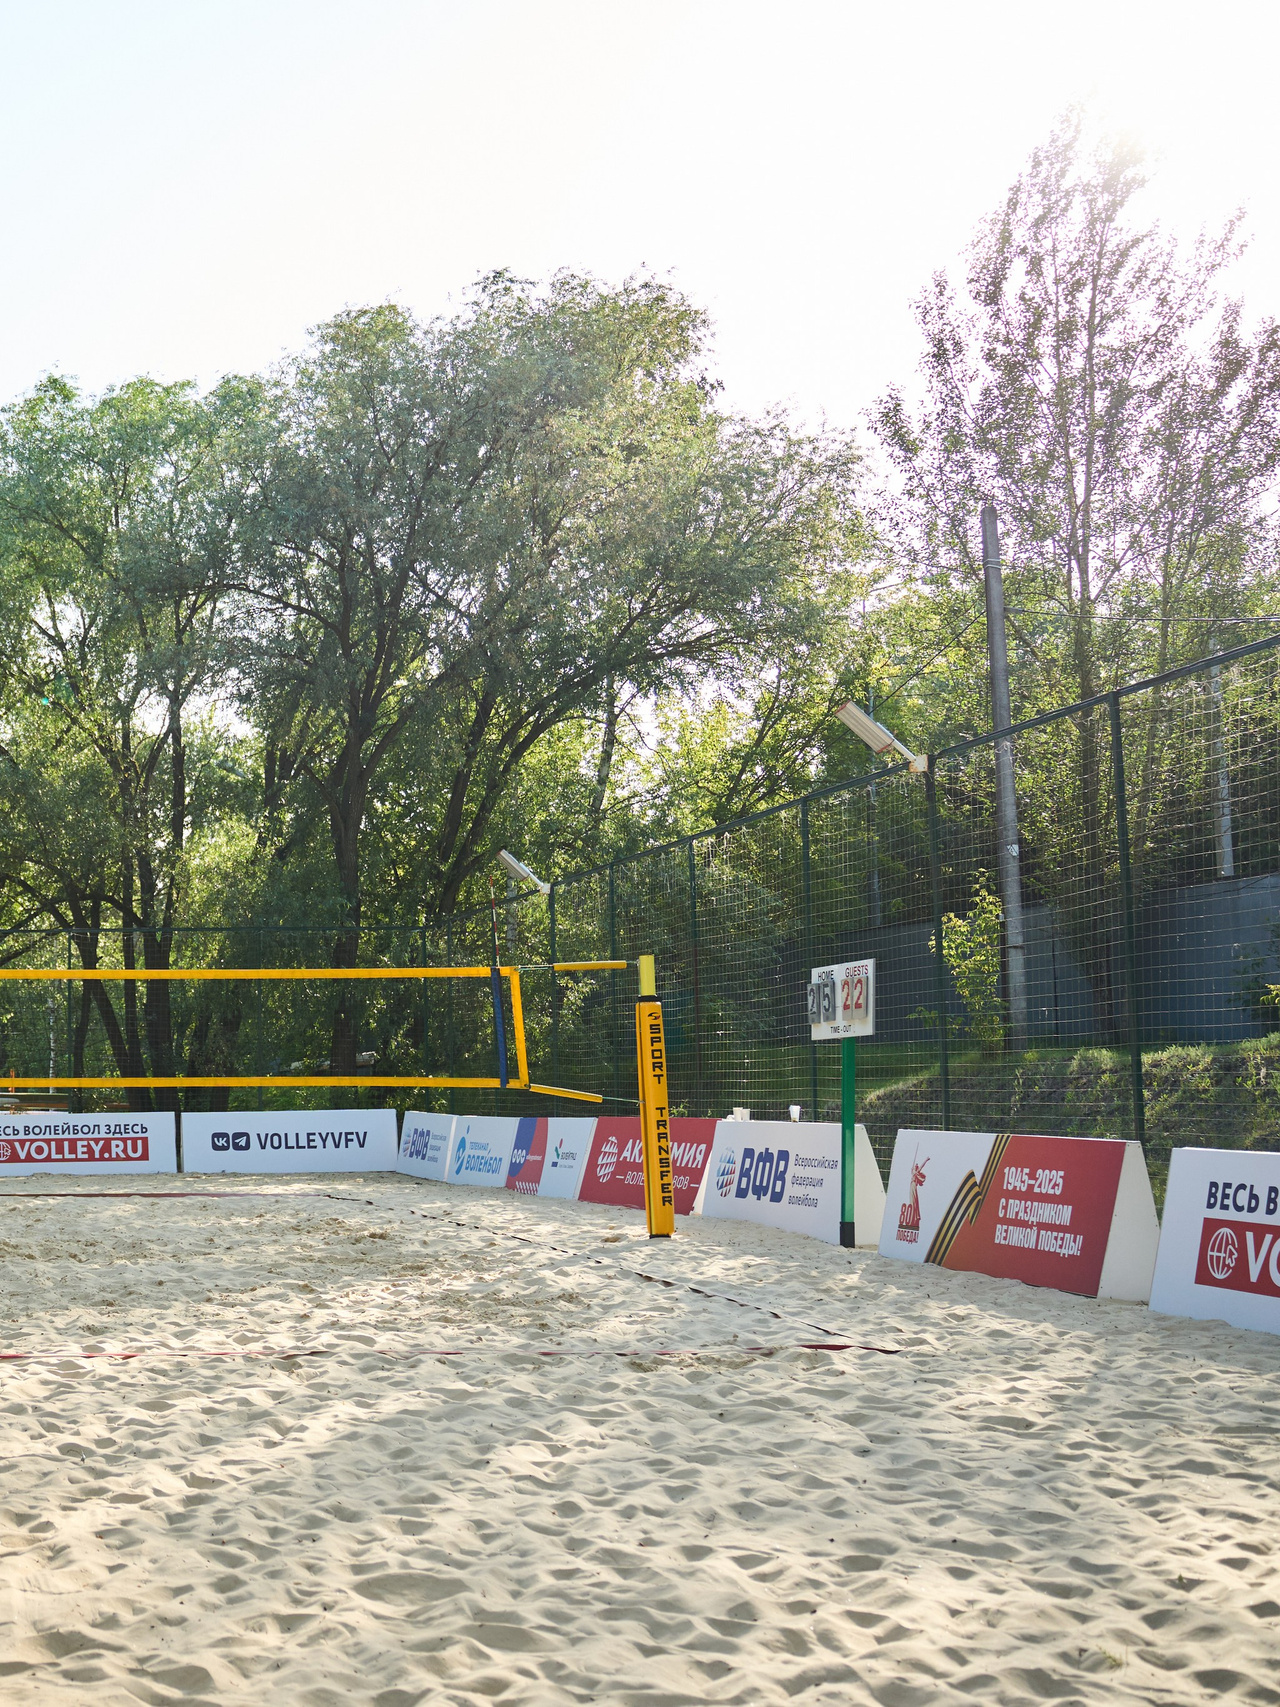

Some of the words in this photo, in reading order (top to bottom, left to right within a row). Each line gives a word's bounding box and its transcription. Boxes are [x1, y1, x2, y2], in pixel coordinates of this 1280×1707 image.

[818, 970, 834, 981] HOME
[845, 965, 868, 978] GUESTS
[649, 1024, 664, 1085] SPORT
[23, 1122, 101, 1136] ВОЛЕЙБОЛ
[104, 1123, 148, 1136] ЗДЕСЬ
[256, 1131, 368, 1150] VOLLEYVFV
[14, 1139, 143, 1160] VOLLEY.RU
[409, 1128, 431, 1161] ВФВ
[620, 1139, 707, 1168] АКМИЯ
[655, 1107, 673, 1207] TRANSFER
[794, 1154, 839, 1170] Всероссийская
[735, 1147, 790, 1203] ВФВ
[791, 1173, 824, 1189] федерация
[788, 1194, 819, 1208] волейбола
[1206, 1181, 1260, 1213] ВЕСЬ
[899, 1203, 913, 1226] 80
[998, 1198, 1006, 1218] С
[1006, 1199, 1073, 1226] ПРАЗДНИКОМ
[994, 1224, 1038, 1249] ВЕЛИКОЙ
[1037, 1230, 1084, 1258] ПОБЕДЫ!
